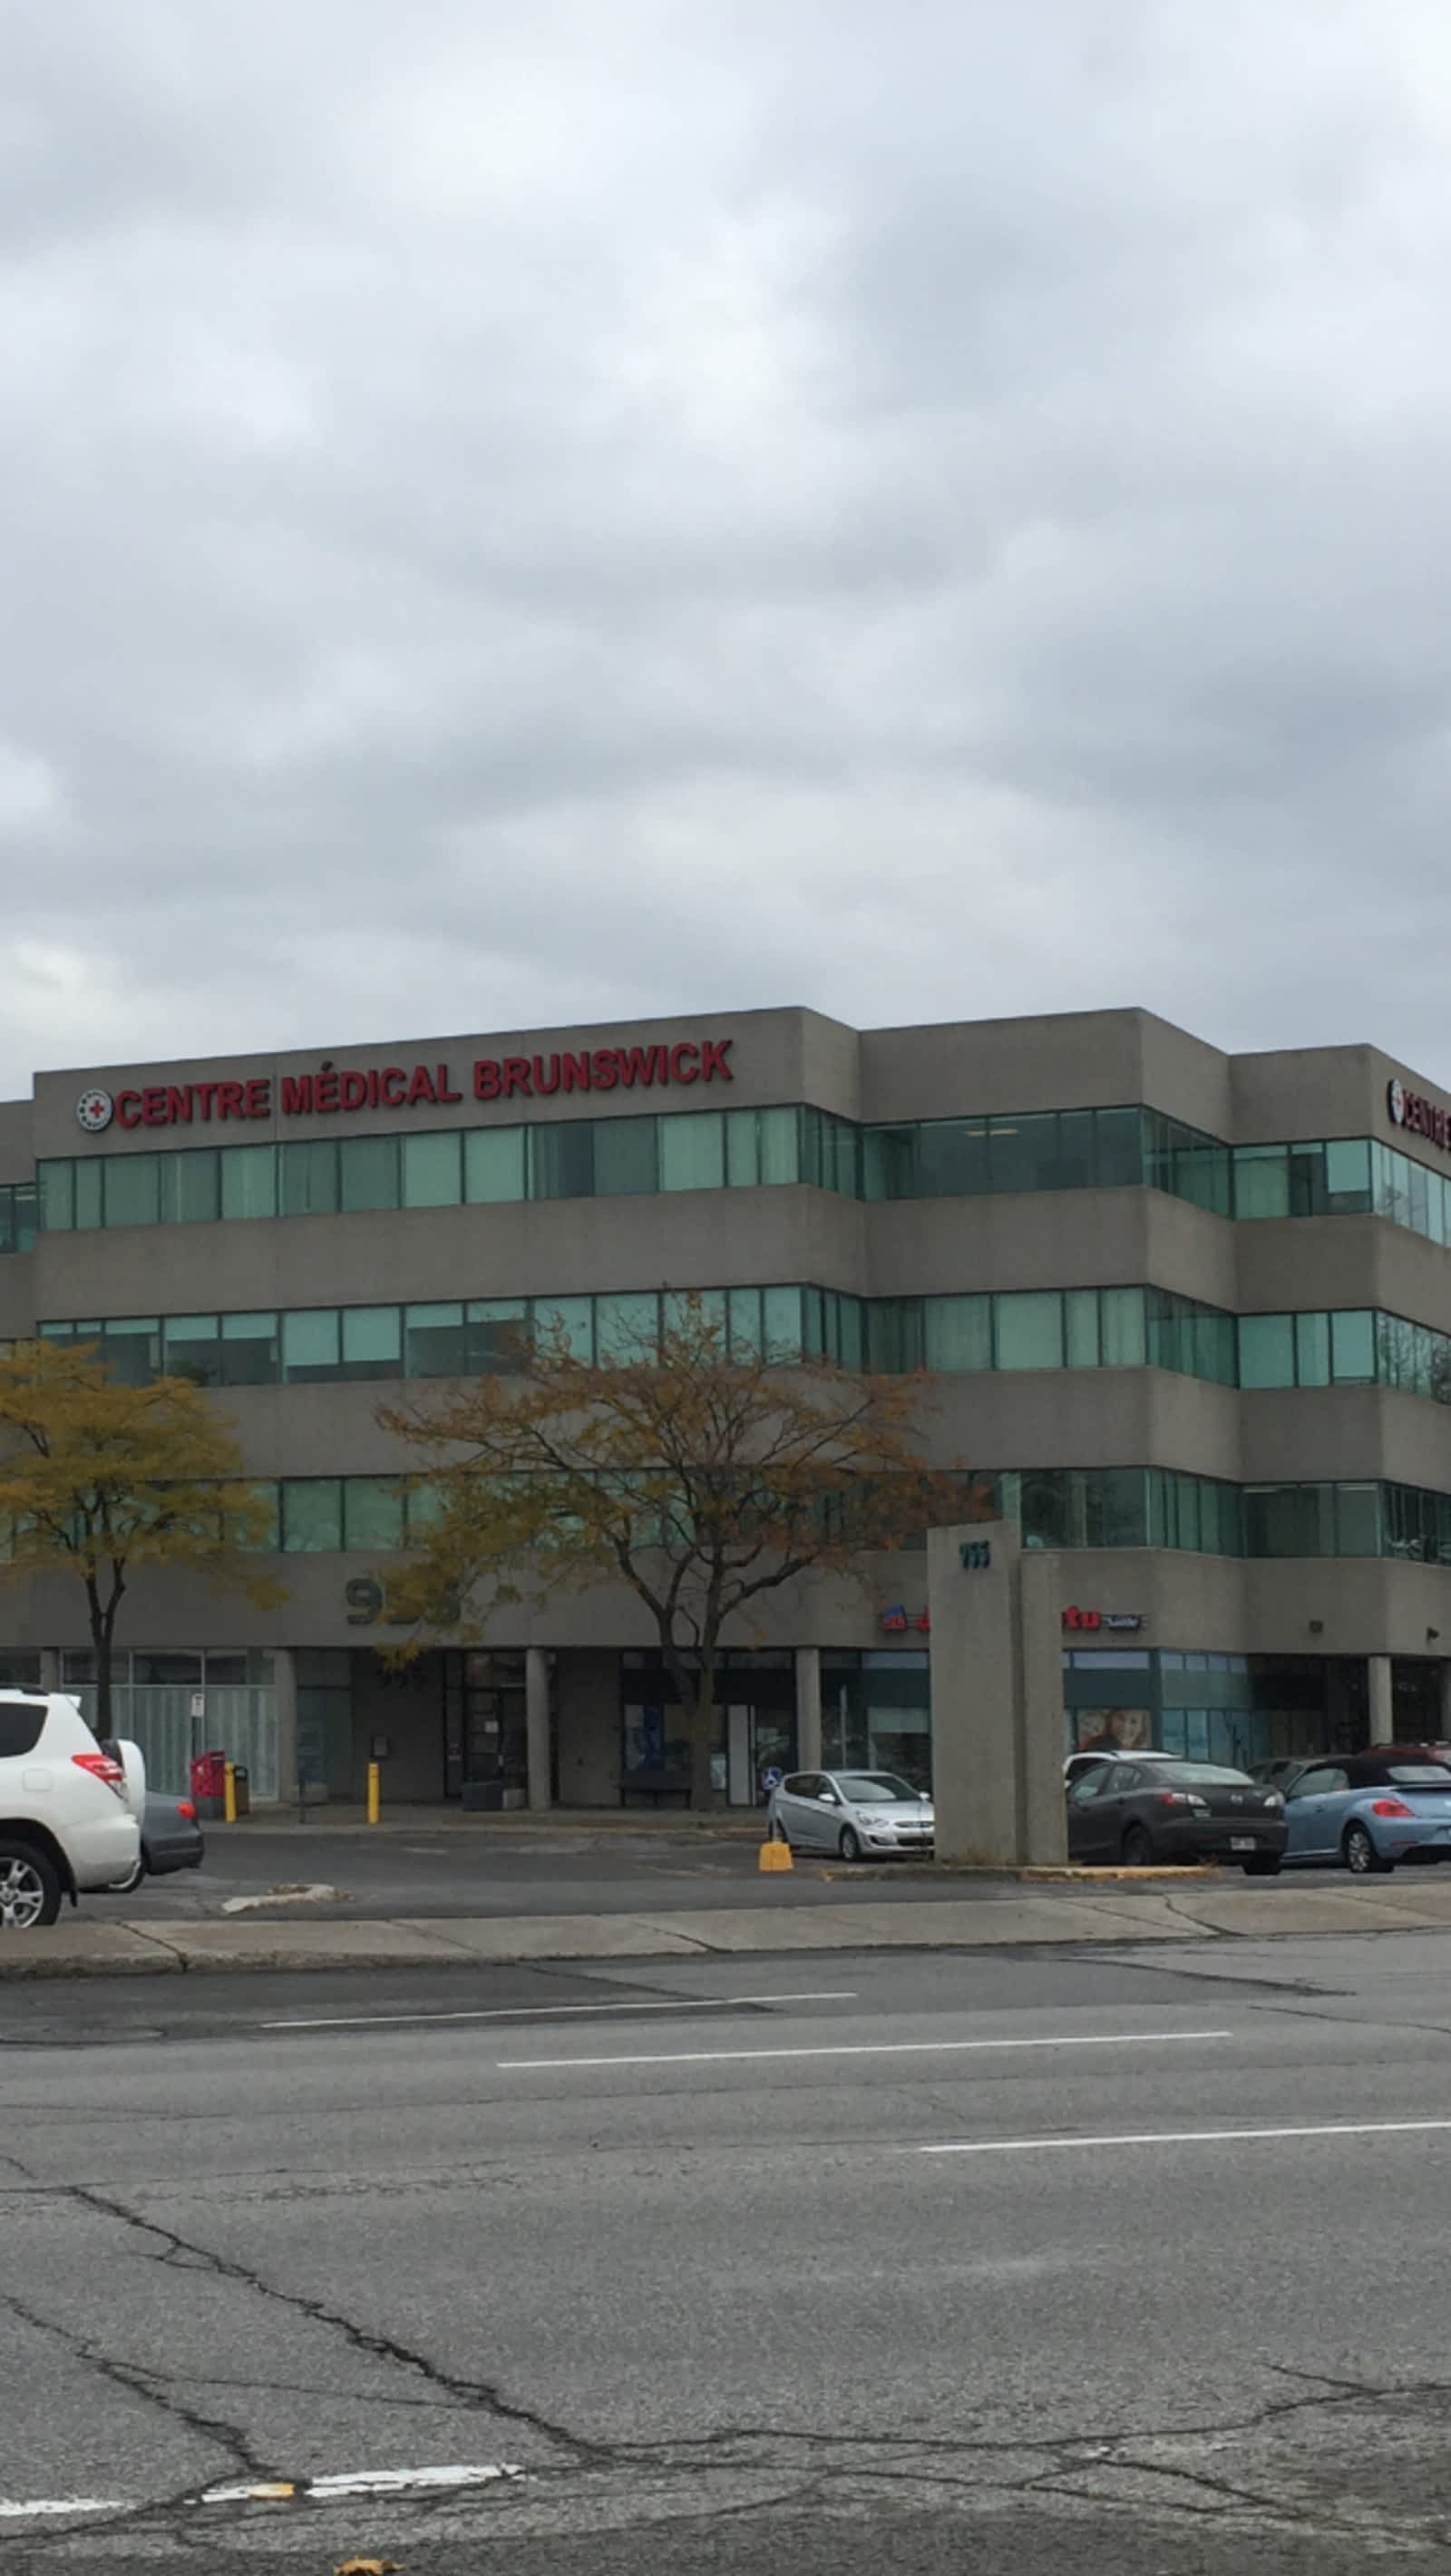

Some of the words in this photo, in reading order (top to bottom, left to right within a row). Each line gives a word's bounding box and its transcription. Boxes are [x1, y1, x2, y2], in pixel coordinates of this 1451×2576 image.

[114, 1078, 270, 1128] CENTRE
[280, 1060, 463, 1115] MÉDICAL
[472, 1039, 734, 1101] BRUNSWICK
